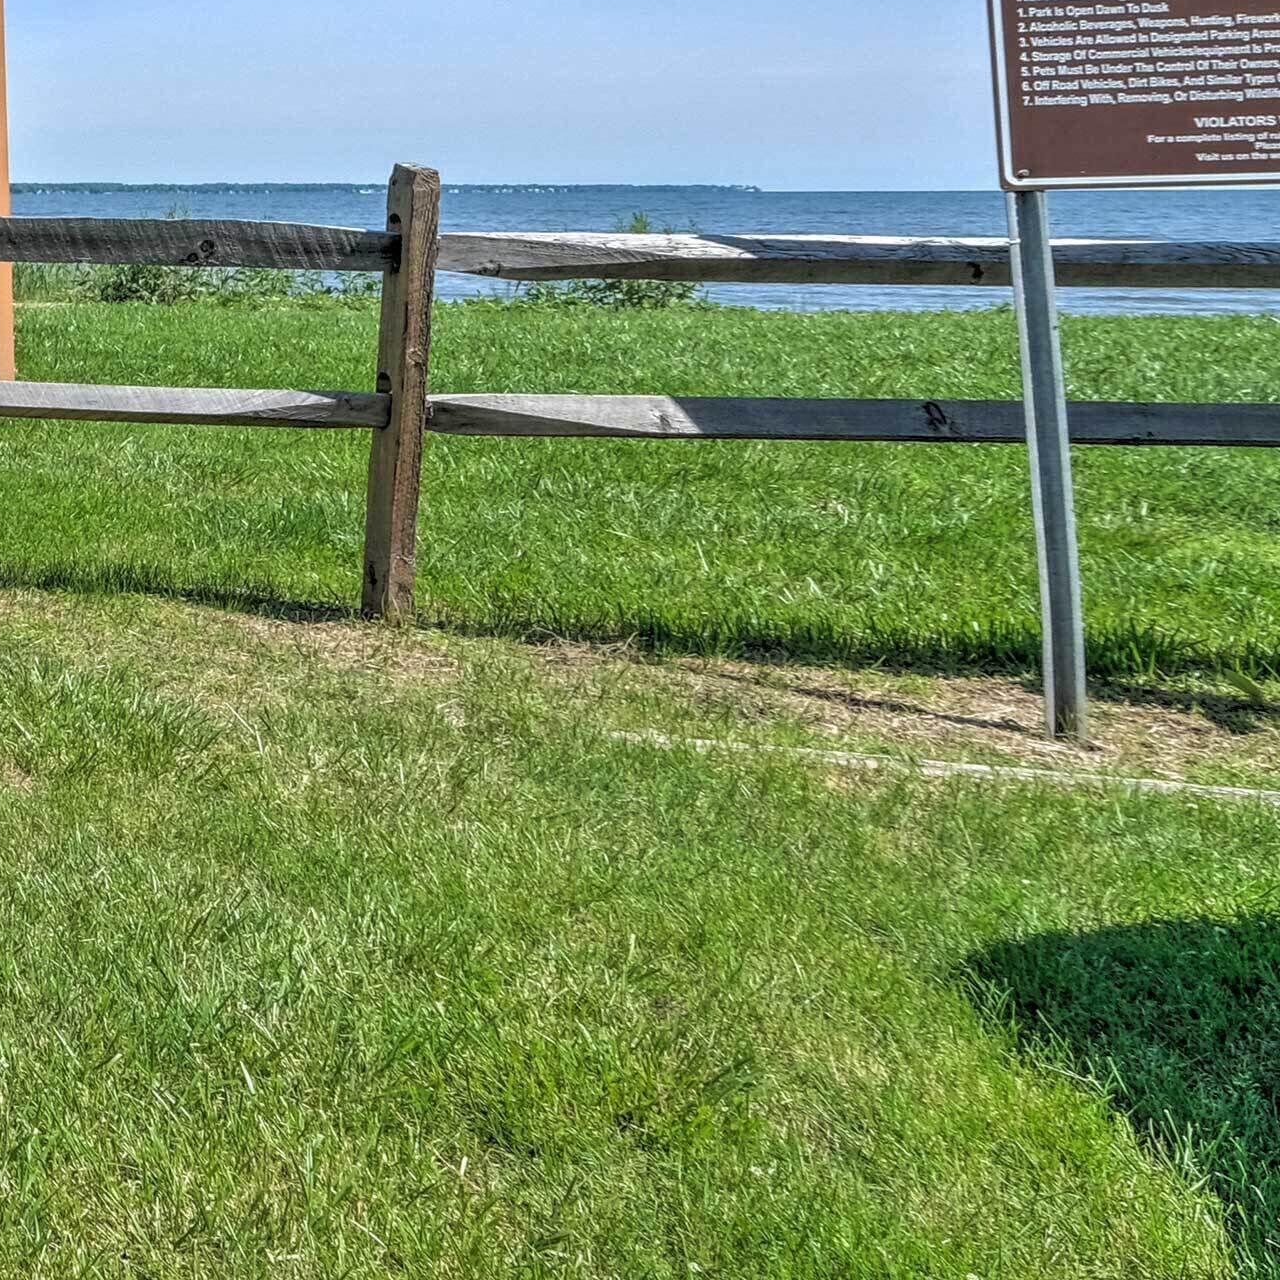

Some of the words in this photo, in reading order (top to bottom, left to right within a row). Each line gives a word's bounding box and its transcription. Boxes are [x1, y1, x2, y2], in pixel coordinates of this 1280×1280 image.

[1016, 8, 1027, 17] 1.
[1028, 7, 1053, 17] Park
[1066, 5, 1095, 17] Open
[1095, 5, 1126, 14] Dawn
[1126, 4, 1140, 13] To
[1141, 2, 1170, 13] Dusk
[1017, 23, 1028, 32] 2.
[1029, 21, 1078, 32] Alcoholic
[1019, 37, 1030, 47] 3.
[1030, 36, 1074, 47] Vehicles
[1074, 35, 1095, 45] Are
[1095, 34, 1137, 44] Allowed
[1149, 31, 1209, 44] Designated
[1209, 30, 1251, 41] Parking
[1020, 52, 1031, 61] 4.
[1031, 51, 1072, 63] Storage
[1088, 48, 1151, 60] Commercial
[1252, 43, 1263, 54] Is
[1021, 67, 1031, 76] 5.
[1032, 66, 1057, 76] Pets
[1057, 65, 1084, 75] Must
[1084, 64, 1100, 74] Be
[1101, 63, 1134, 74] Under
[1134, 62, 1155, 72] The
[1156, 61, 1196, 72] Control
[1211, 59, 1239, 70] Their
[1022, 81, 1033, 91] 6.
[1033, 80, 1050, 90] Off
[1051, 80, 1080, 90] Road
[1128, 77, 1149, 88] Dirt
[1184, 75, 1206, 86] And
[1206, 74, 1244, 85] Similar
[1243, 73, 1276, 86] Types
[1023, 96, 1033, 106] 7.
[1034, 95, 1088, 107] Interfering
[1173, 91, 1188, 101] Or
[1188, 89, 1244, 102] Disturbing
[1193, 115, 1277, 127] VIOLATORS
[1146, 135, 1165, 143] For
[1175, 133, 1222, 143] complete
[1223, 131, 1256, 142] listing
[1257, 131, 1268, 140] of
